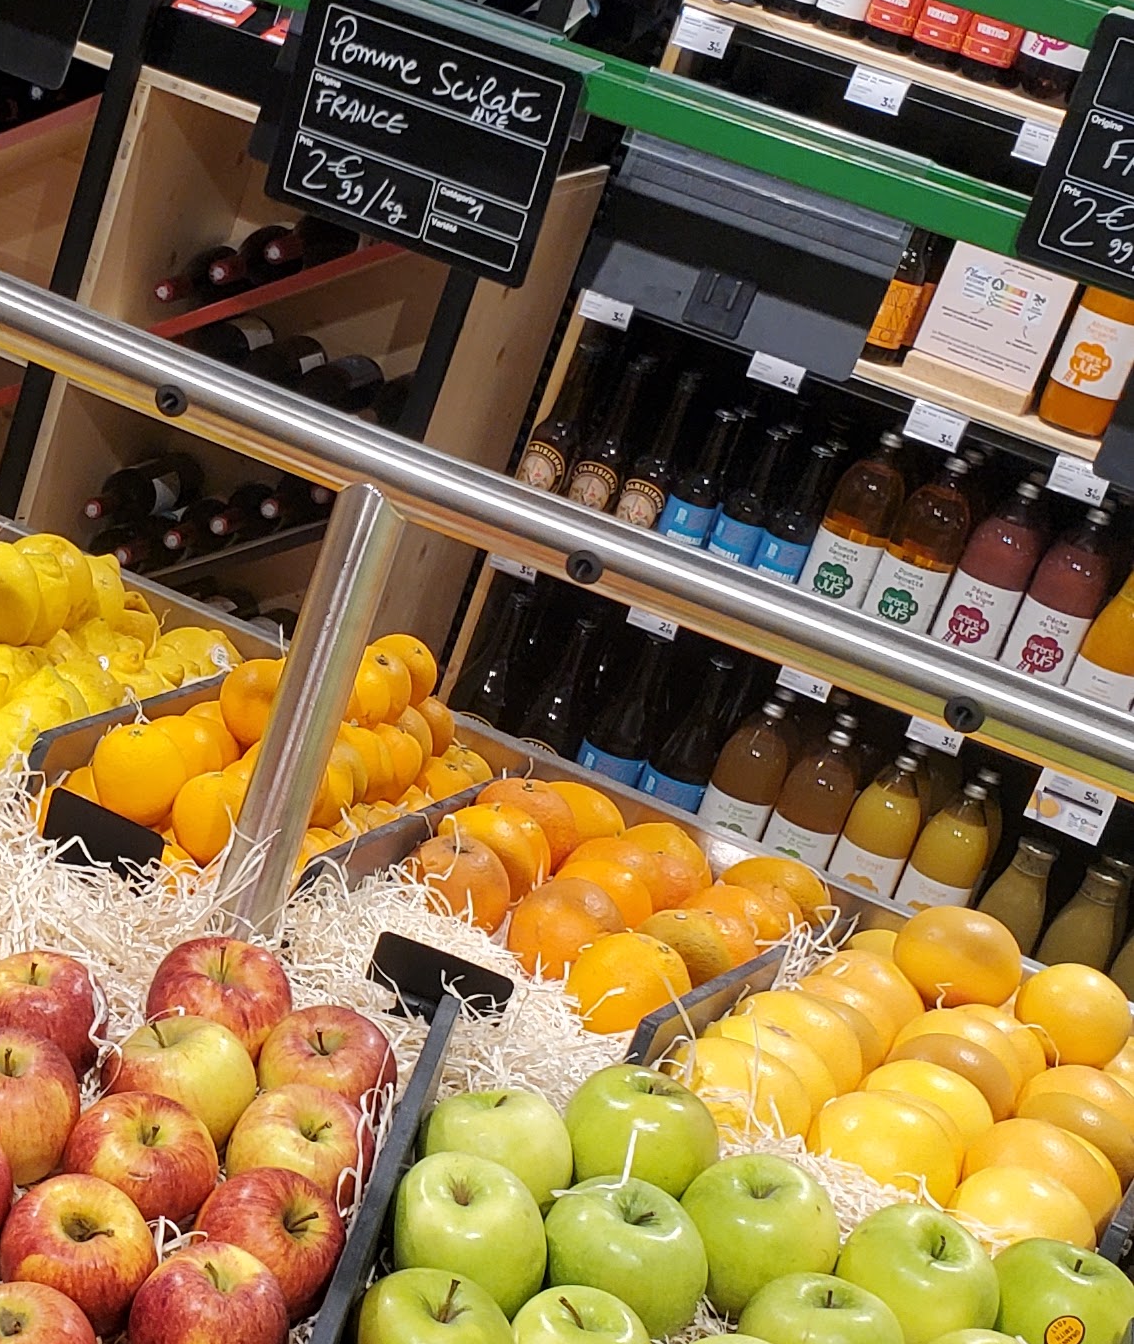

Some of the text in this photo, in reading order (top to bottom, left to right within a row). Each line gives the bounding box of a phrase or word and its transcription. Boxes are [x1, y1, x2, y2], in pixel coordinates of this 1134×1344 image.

[330, 15, 541, 123] Pomme Scilate
[315, 72, 341, 89] Origine
[316, 89, 408, 134] FRANCE
[470, 107, 508, 129] HVE
[1091, 114, 1124, 132] Origine
[299, 135, 313, 148] Prix
[440, 186, 476, 206] Catégorie
[1063, 184, 1082, 198] Prix
[469, 204, 484, 222] 1
[432, 217, 457, 234] Variété
[1073, 359, 1102, 376] JUS
[834, 542, 858, 555] Pomme
[898, 567, 923, 581] Pomme
[817, 578, 843, 594] JUS
[971, 585, 992, 598] Pêche
[975, 595, 994, 607] Vigne
[881, 605, 908, 621] JUS
[1046, 615, 1068, 627] Pêche
[953, 623, 979, 639] JUS
[1039, 620, 1070, 636] de Vigne
[1026, 653, 1054, 669] JUS
